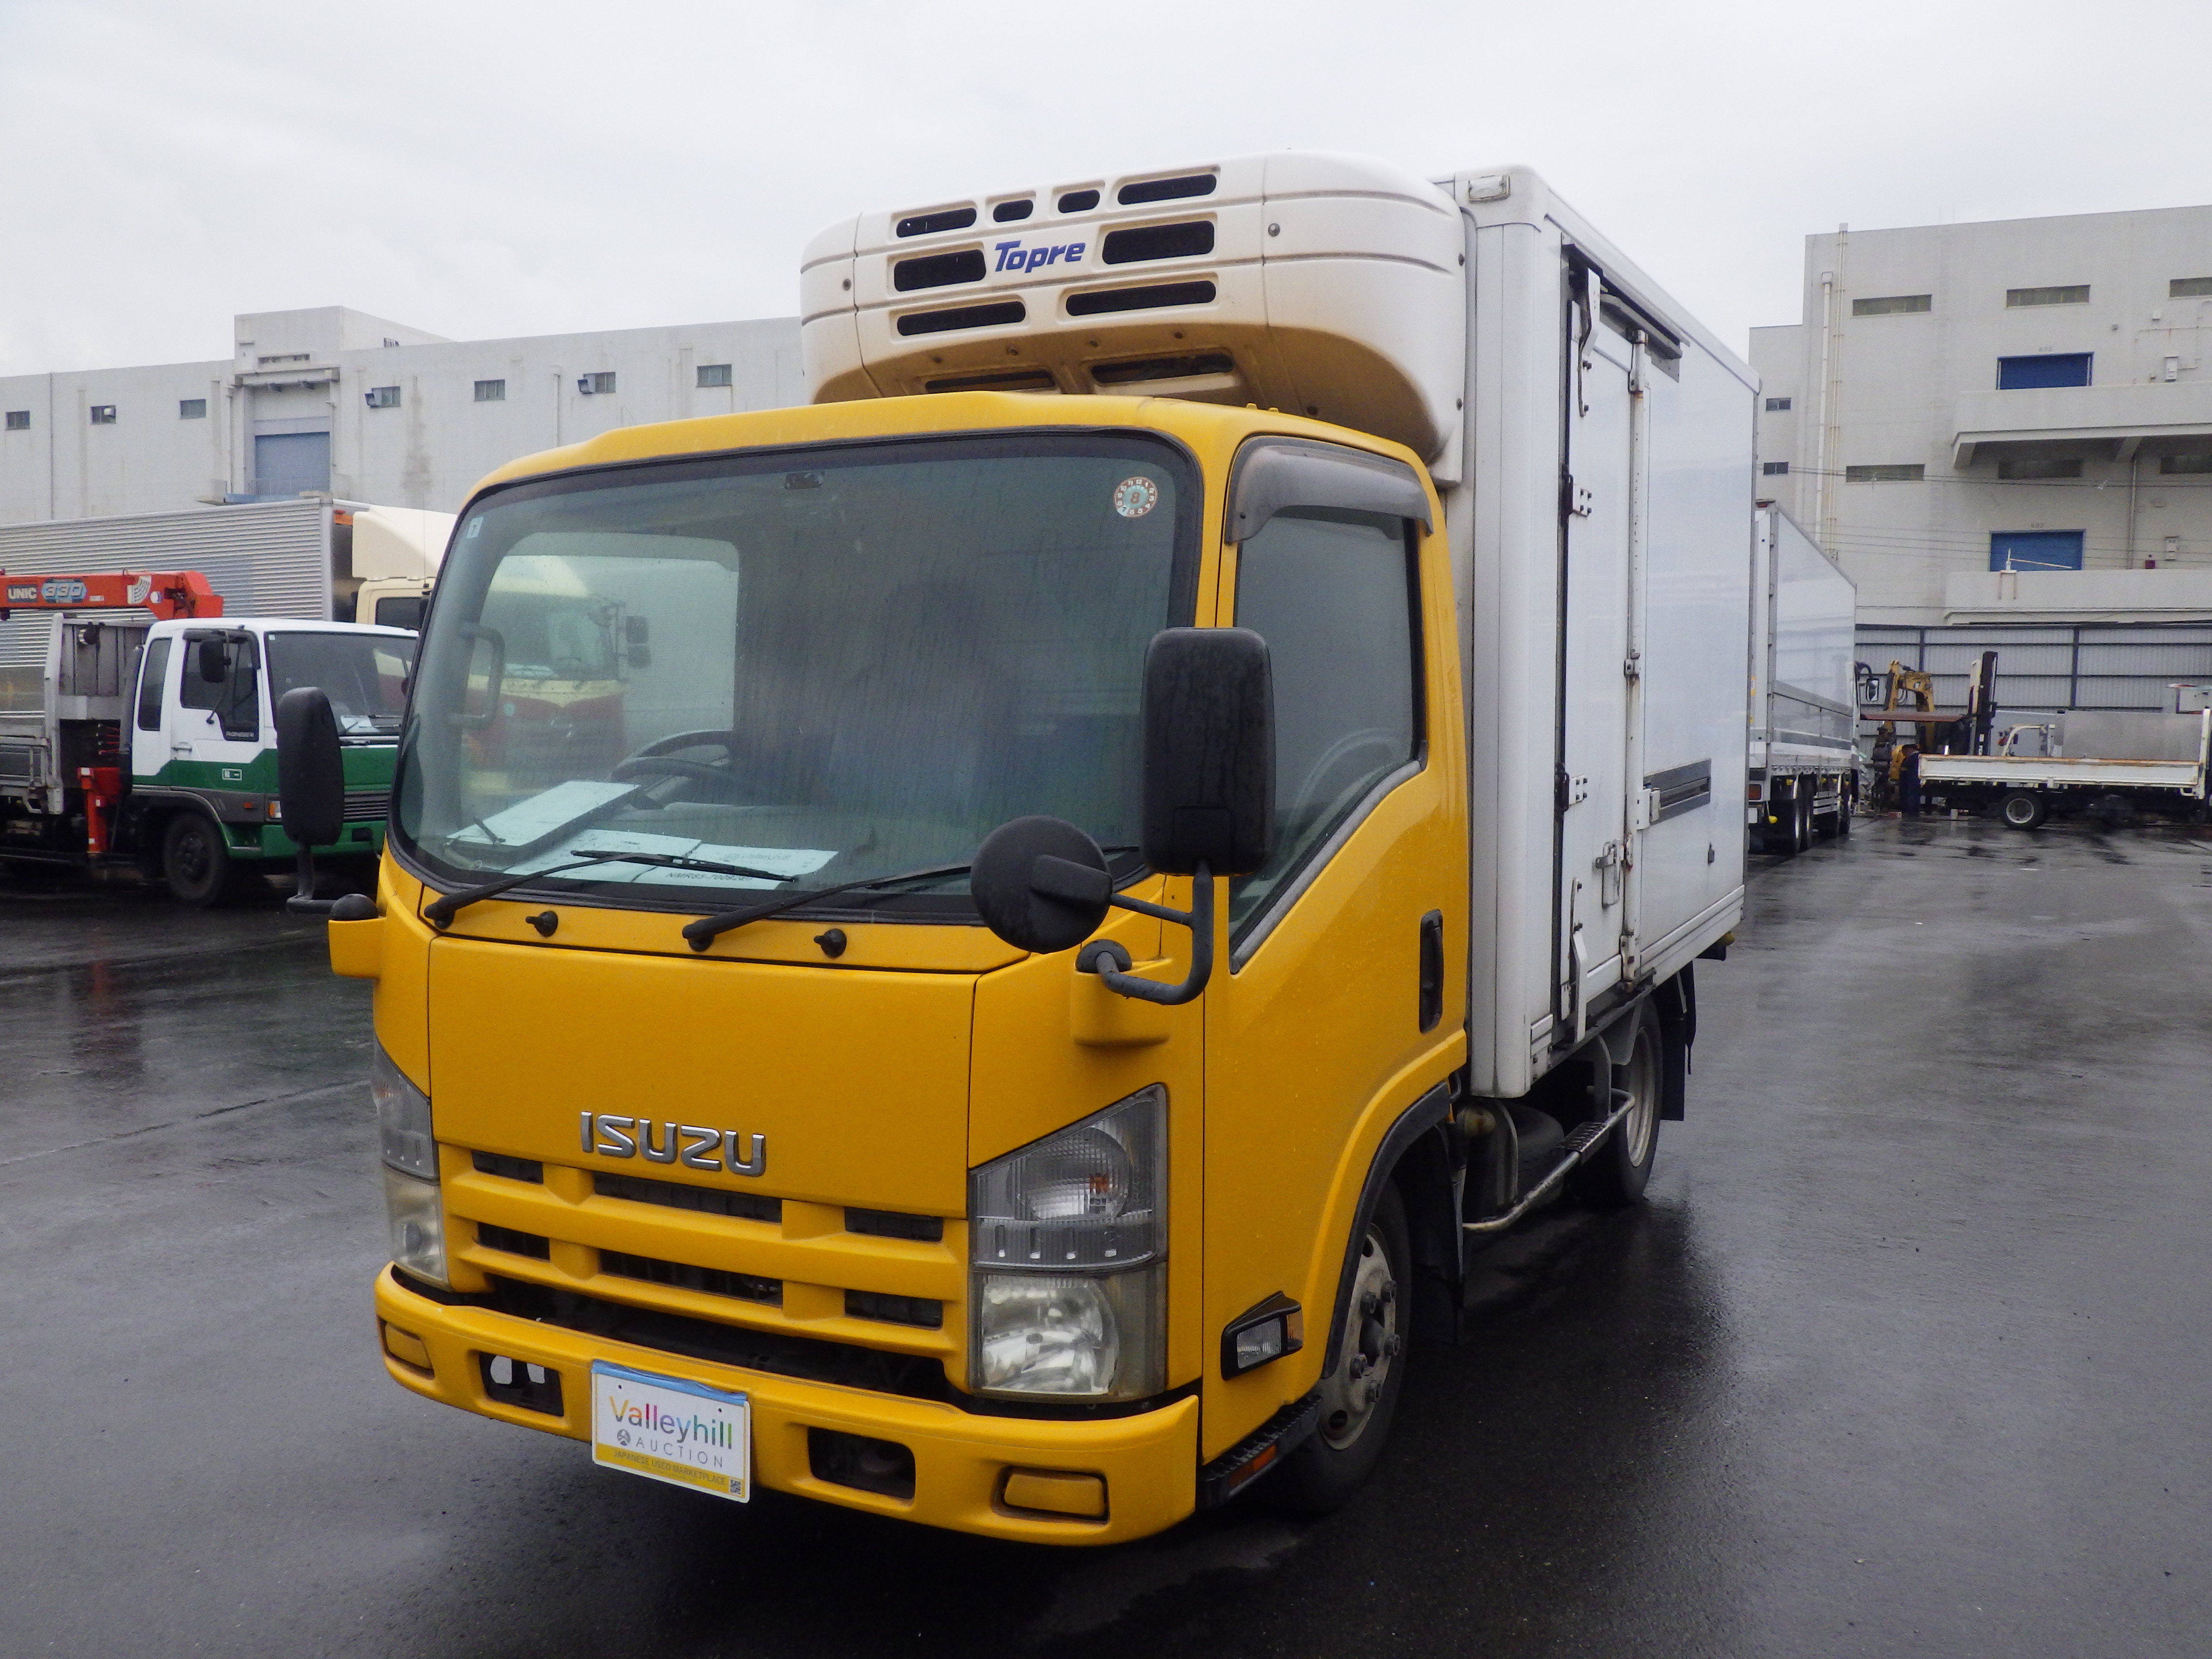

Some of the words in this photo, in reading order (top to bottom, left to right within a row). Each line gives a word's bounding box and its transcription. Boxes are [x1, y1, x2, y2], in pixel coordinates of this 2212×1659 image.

[995, 240, 1086, 273] Topre
[1130, 492, 1140, 504] 8
[8, 587, 37, 599] UNIC
[45, 583, 83, 598] 330
[581, 1111, 766, 1177] ISUZU
[609, 1395, 732, 1449] Valleyhill
[614, 1450, 649, 1466] JAPANESE
[652, 1459, 671, 1471] USED
[672, 1464, 725, 1485] MARKETPLACE
[636, 1437, 722, 1468] AUCTION
